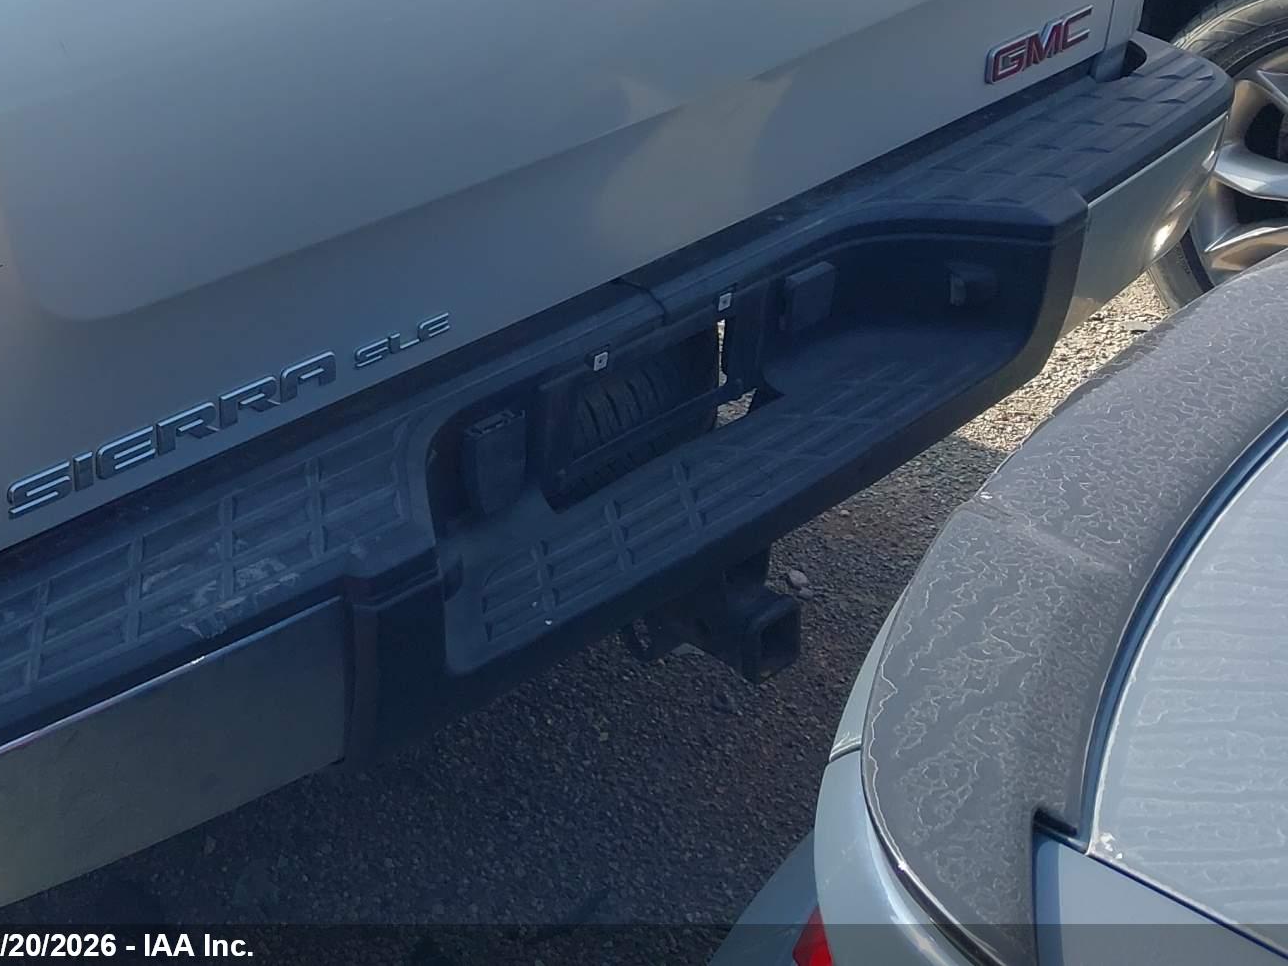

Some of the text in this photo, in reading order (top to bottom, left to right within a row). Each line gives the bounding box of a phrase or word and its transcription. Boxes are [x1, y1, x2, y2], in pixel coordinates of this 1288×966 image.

[984, 4, 1093, 84] GMC
[6, 312, 450, 518] SIERRA SLE
